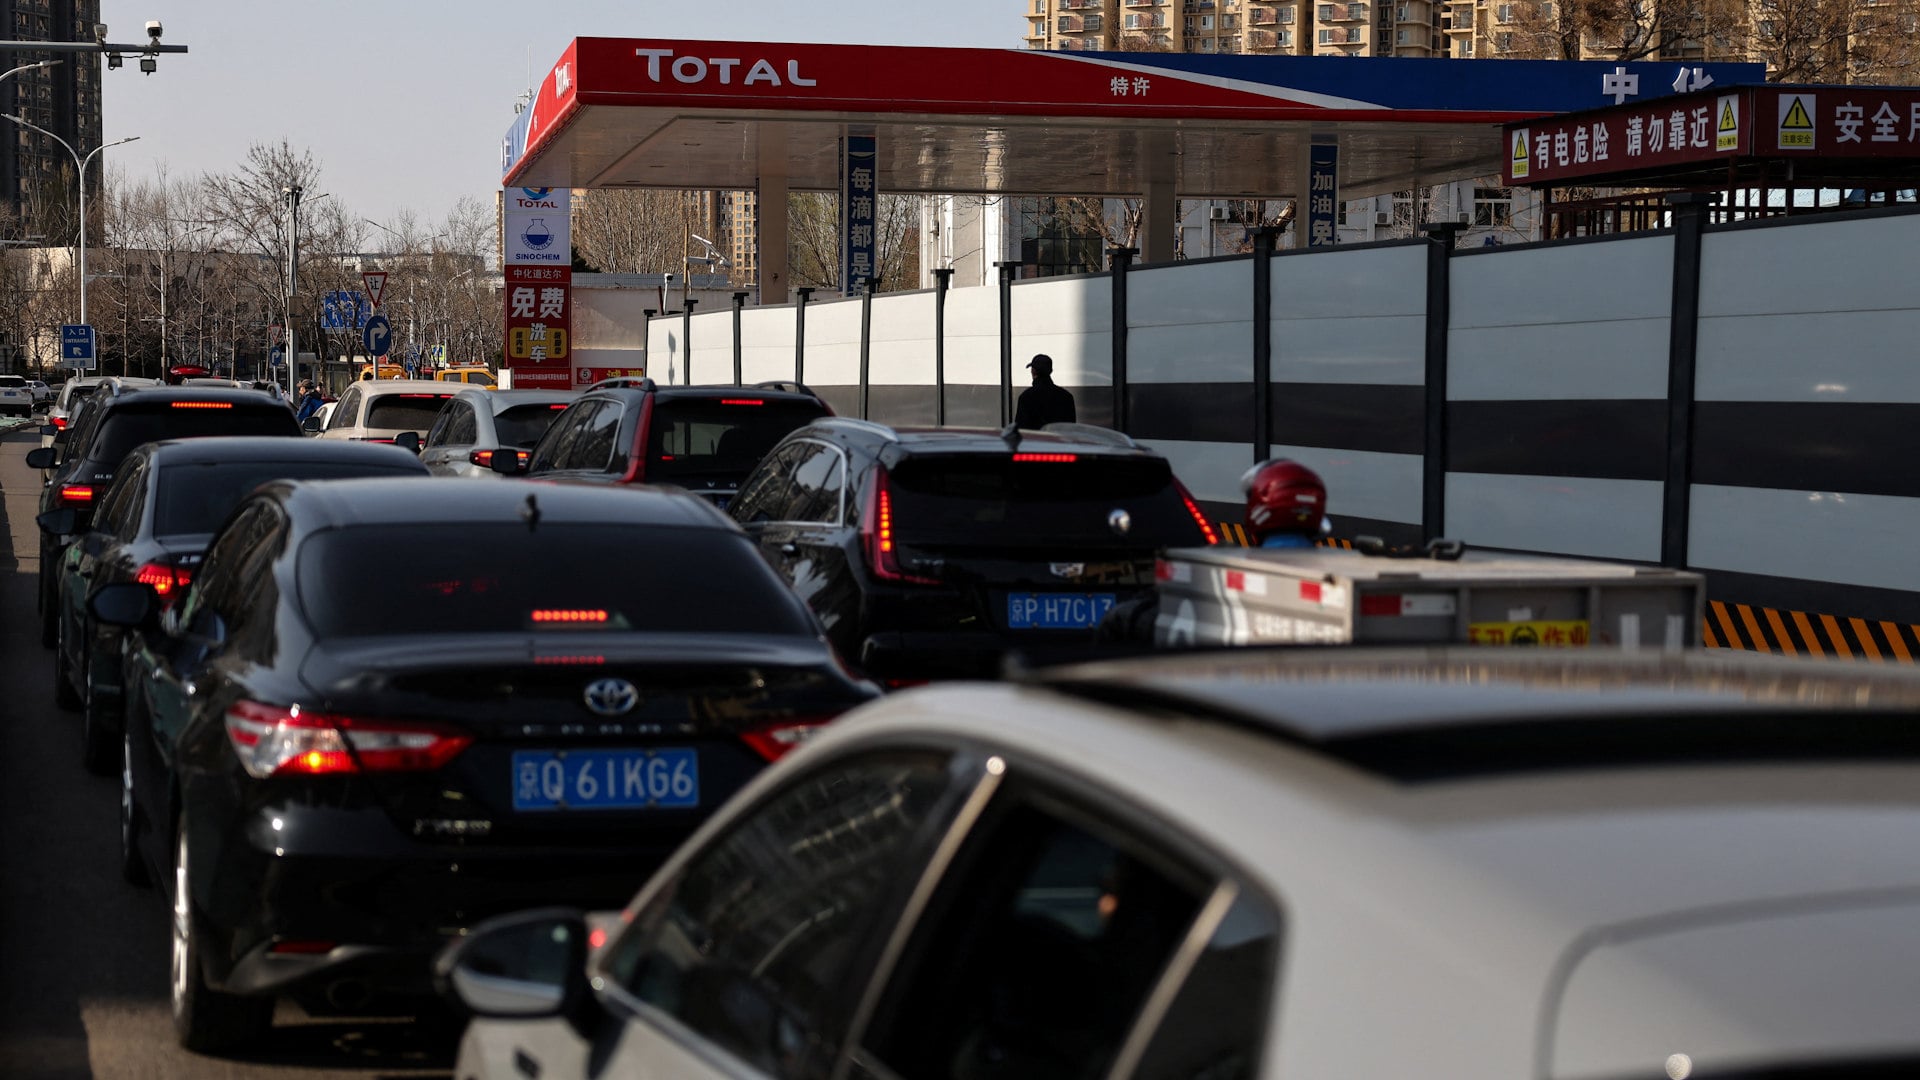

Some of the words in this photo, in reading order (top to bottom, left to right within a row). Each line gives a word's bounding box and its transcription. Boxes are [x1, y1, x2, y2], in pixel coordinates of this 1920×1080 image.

[635, 48, 817, 87] TOTAL
[1110, 77, 1150, 96] 特许
[1535, 121, 1609, 170] 有电危险
[1626, 105, 1709, 156] 请勿靠近
[1782, 133, 1812, 144] 注意安全
[516, 198, 559, 209] TOTAL
[1312, 170, 1334, 246] 加油免
[515, 253, 560, 261] SINOCHEM
[513, 268, 562, 279] 中化道达尔
[370, 277, 379, 289] 让
[511, 287, 564, 318] 免费
[69, 328, 86, 336] 入口
[530, 322, 547, 363] 洗车
